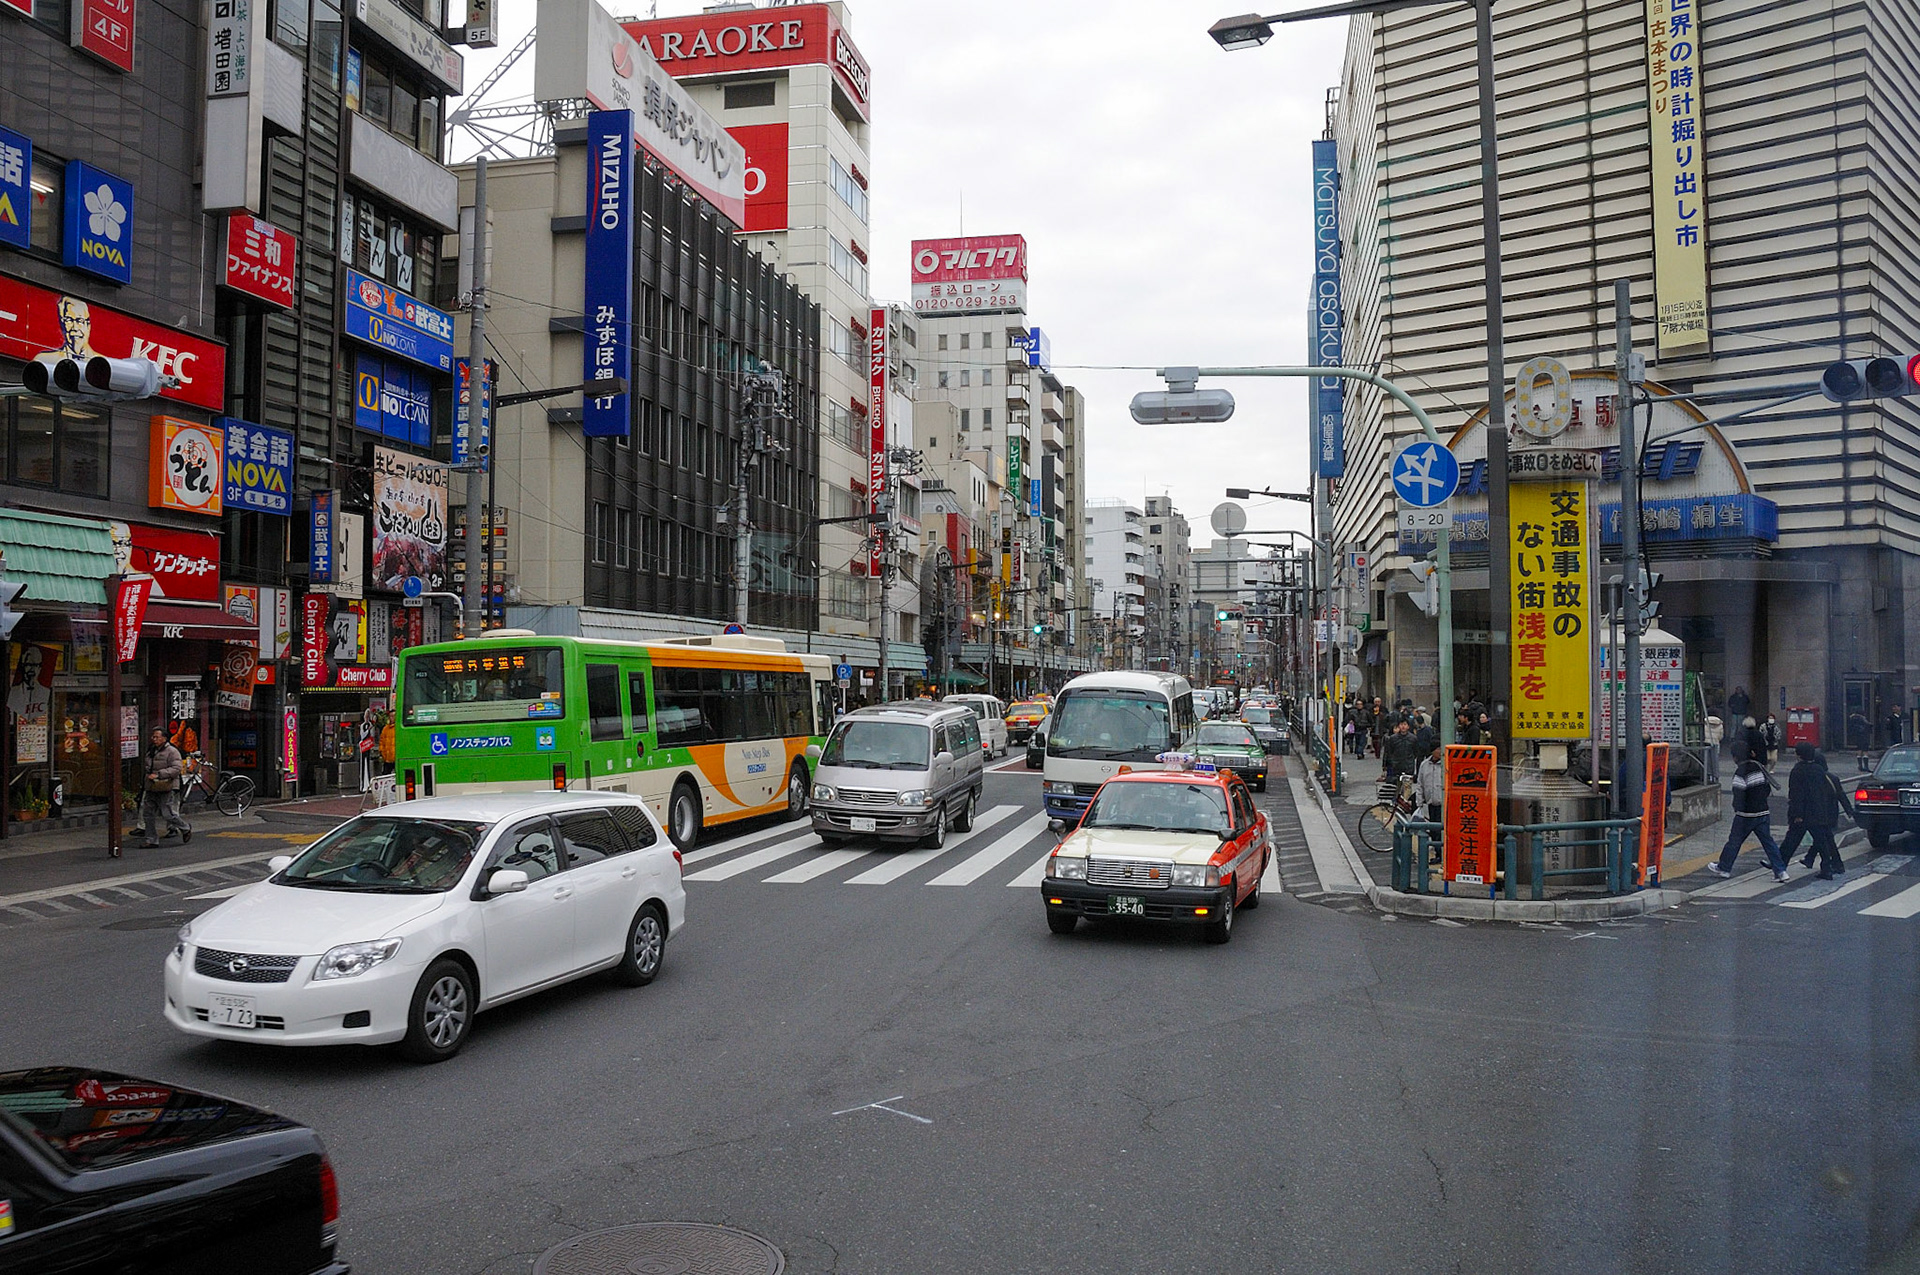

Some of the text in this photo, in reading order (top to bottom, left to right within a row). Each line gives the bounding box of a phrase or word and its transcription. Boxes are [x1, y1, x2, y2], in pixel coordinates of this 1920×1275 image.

[94, 17, 122, 41] 4F
[470, 29, 487, 41] 5F
[1650, 20, 1668, 114] 古本まつり
[643, 75, 731, 180] 損保ジャパン
[602, 134, 622, 231] MIZUHO
[82, 238, 126, 268] NOVA
[244, 229, 282, 267] 三和
[228, 254, 293, 295] ファイナンス
[931, 283, 1001, 297] 振込ローン
[915, 294, 1017, 310] 0120-029-253
[415, 304, 452, 340] 武富士
[131, 336, 196, 384] KFC
[872, 326, 885, 376] カラオケ
[228, 426, 290, 467] 英会話
[1011, 446, 1019, 471] レイク
[169, 444, 213, 494] うどん
[228, 459, 286, 493] NOVA
[227, 486, 241, 501] 3F
[1691, 504, 1744, 529] 桐生
[154, 552, 216, 576] ケンタッキー
[314, 528, 328, 571] 武富士
[1550, 490, 1582, 639] 交通事故の
[431, 573, 442, 587] 2F
[163, 626, 184, 638] KFC
[304, 599, 319, 681] Cherry Club
[341, 668, 387, 684] Cherry Club
[1516, 721, 1585, 730] 浅草交通安全協会
[451, 736, 512, 749] ノンステップバス
[1459, 794, 1479, 875] 段差注意
[1115, 902, 1144, 915] 35-40
